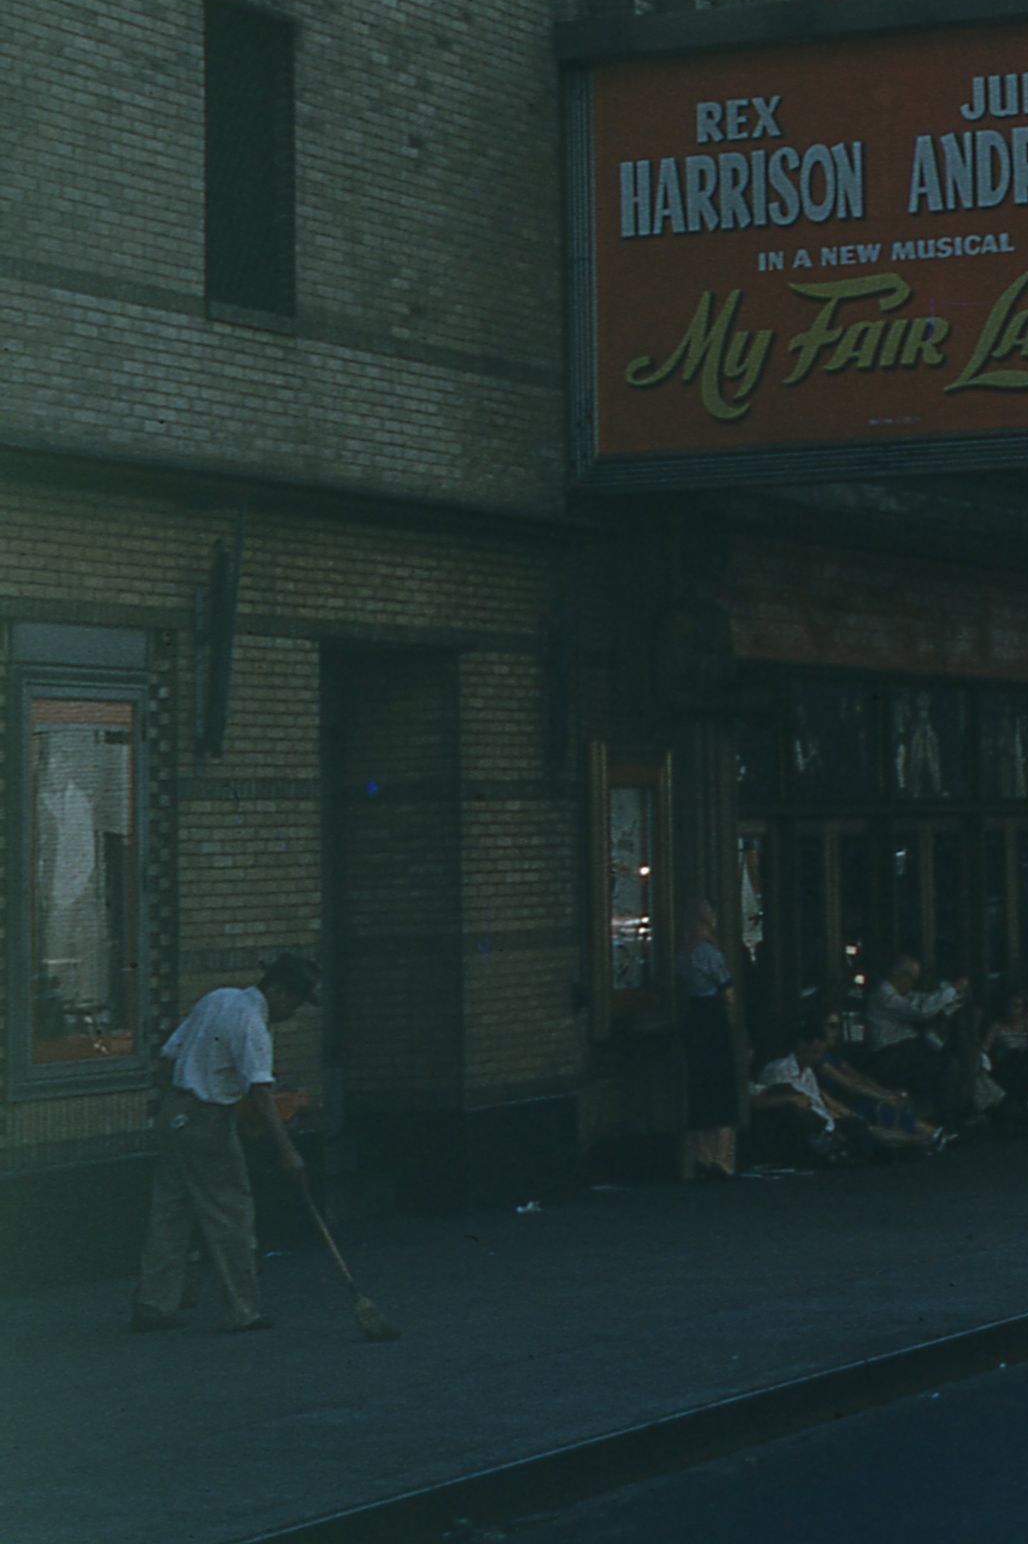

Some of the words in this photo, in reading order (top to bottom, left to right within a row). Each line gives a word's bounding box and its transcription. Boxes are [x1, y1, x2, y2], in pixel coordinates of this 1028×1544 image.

[696, 95, 783, 144] REX
[619, 141, 866, 239] HARRISON
[758, 251, 784, 272] IN
[793, 250, 813, 269] A
[820, 243, 883, 267] NEW
[891, 233, 1016, 262] MUSICAL
[625, 289, 776, 420] My
